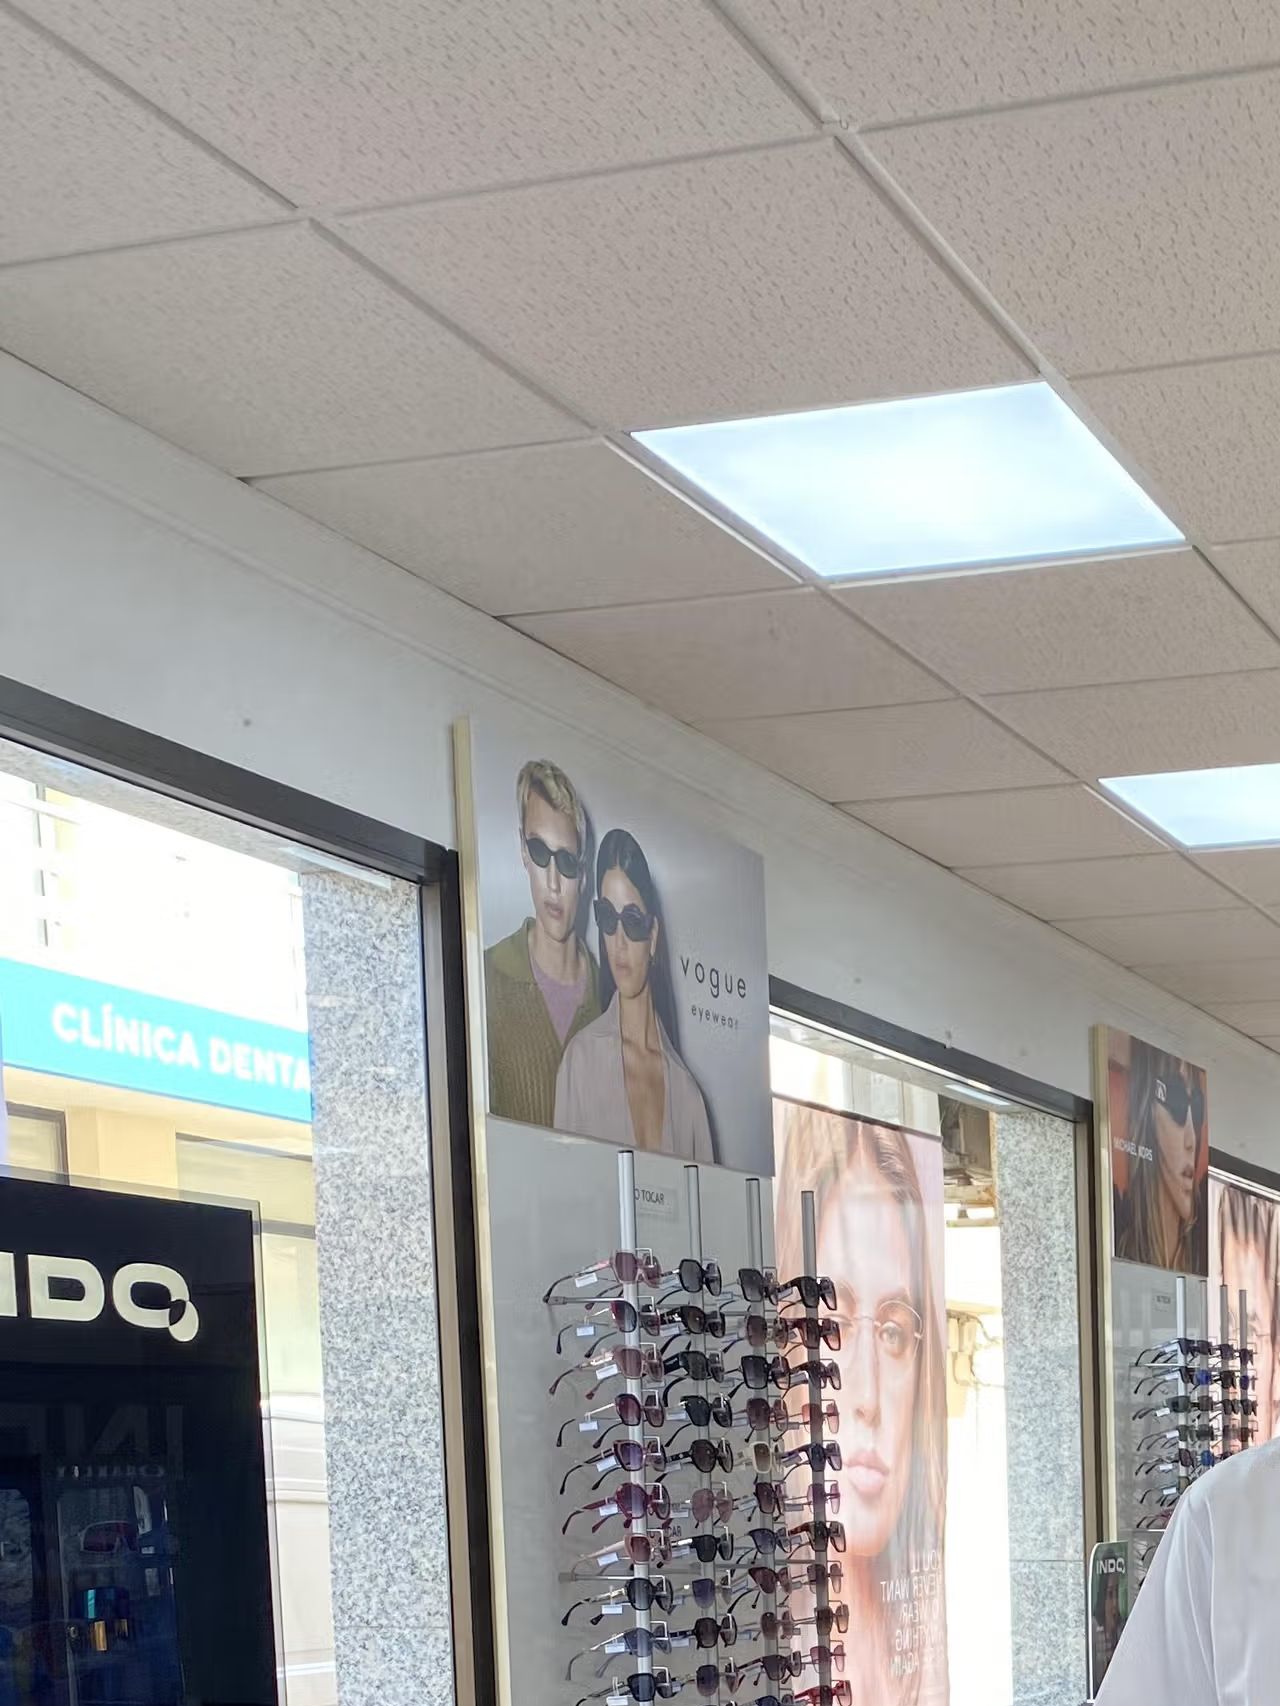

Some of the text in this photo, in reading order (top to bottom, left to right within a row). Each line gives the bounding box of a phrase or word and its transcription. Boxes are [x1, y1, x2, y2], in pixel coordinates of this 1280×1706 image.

[680, 955, 746, 999] vogue
[691, 1004, 739, 1031] eyewear
[52, 1002, 312, 1091] CLÍNICA DENTA
[1113, 1136, 1138, 1157] MICHAEL
[641, 1189, 665, 1205] TOCAR
[1097, 1558, 1126, 1574] INDO
